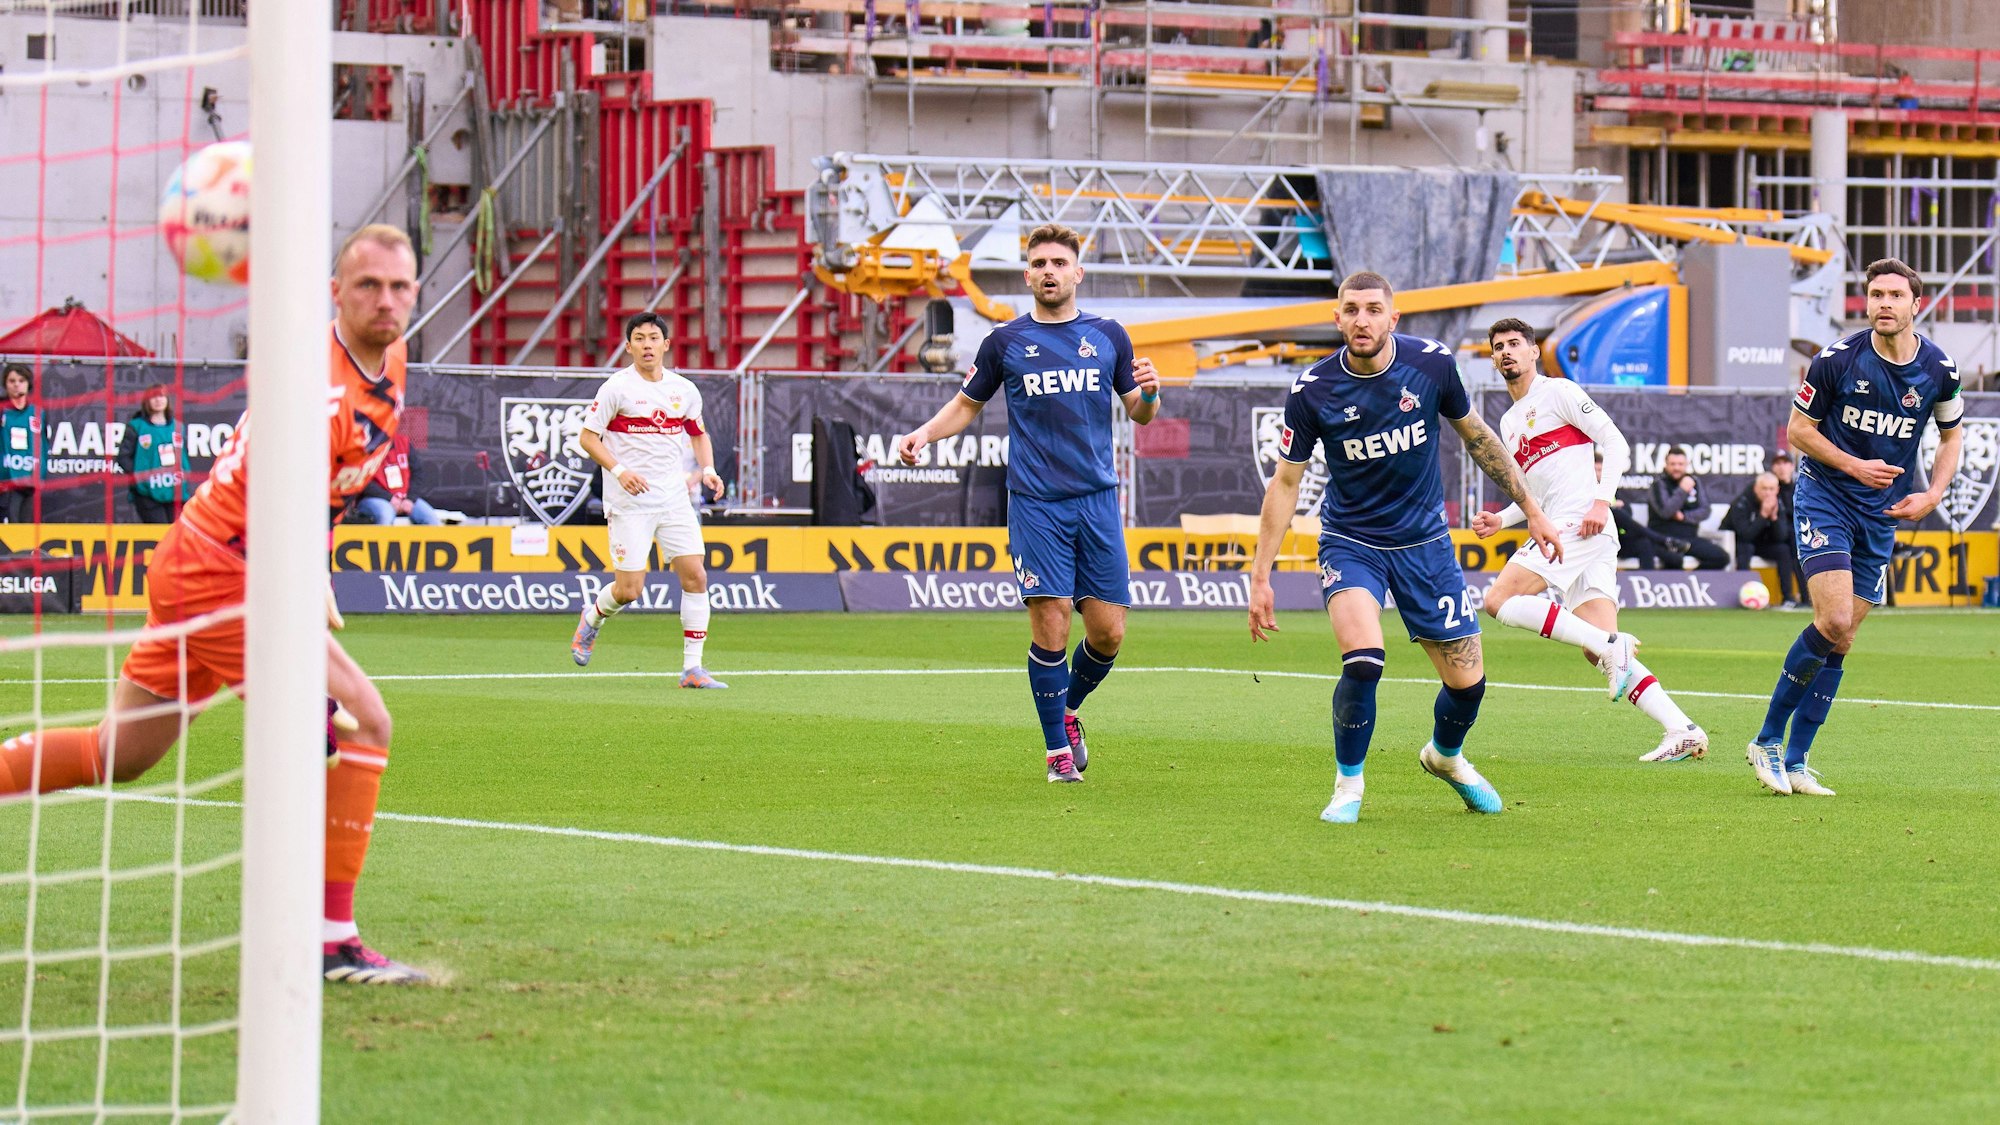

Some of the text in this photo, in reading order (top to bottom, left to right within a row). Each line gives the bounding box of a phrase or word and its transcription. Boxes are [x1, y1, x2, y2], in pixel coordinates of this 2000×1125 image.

[1727, 346, 1785, 364] POTAIN
[1022, 368, 1100, 397] REWE
[47, 421, 126, 456] AAB
[1842, 404, 1917, 439] REWE
[1343, 419, 1428, 461] REWE
[1540, 440, 1561, 456] Bank
[0, 576, 58, 593] SLIGA
[39, 539, 159, 596] WR
[379, 573, 674, 610] Mercedes-Bnz
[1628, 574, 1718, 608] Bank
[1437, 589, 1476, 630] 24
